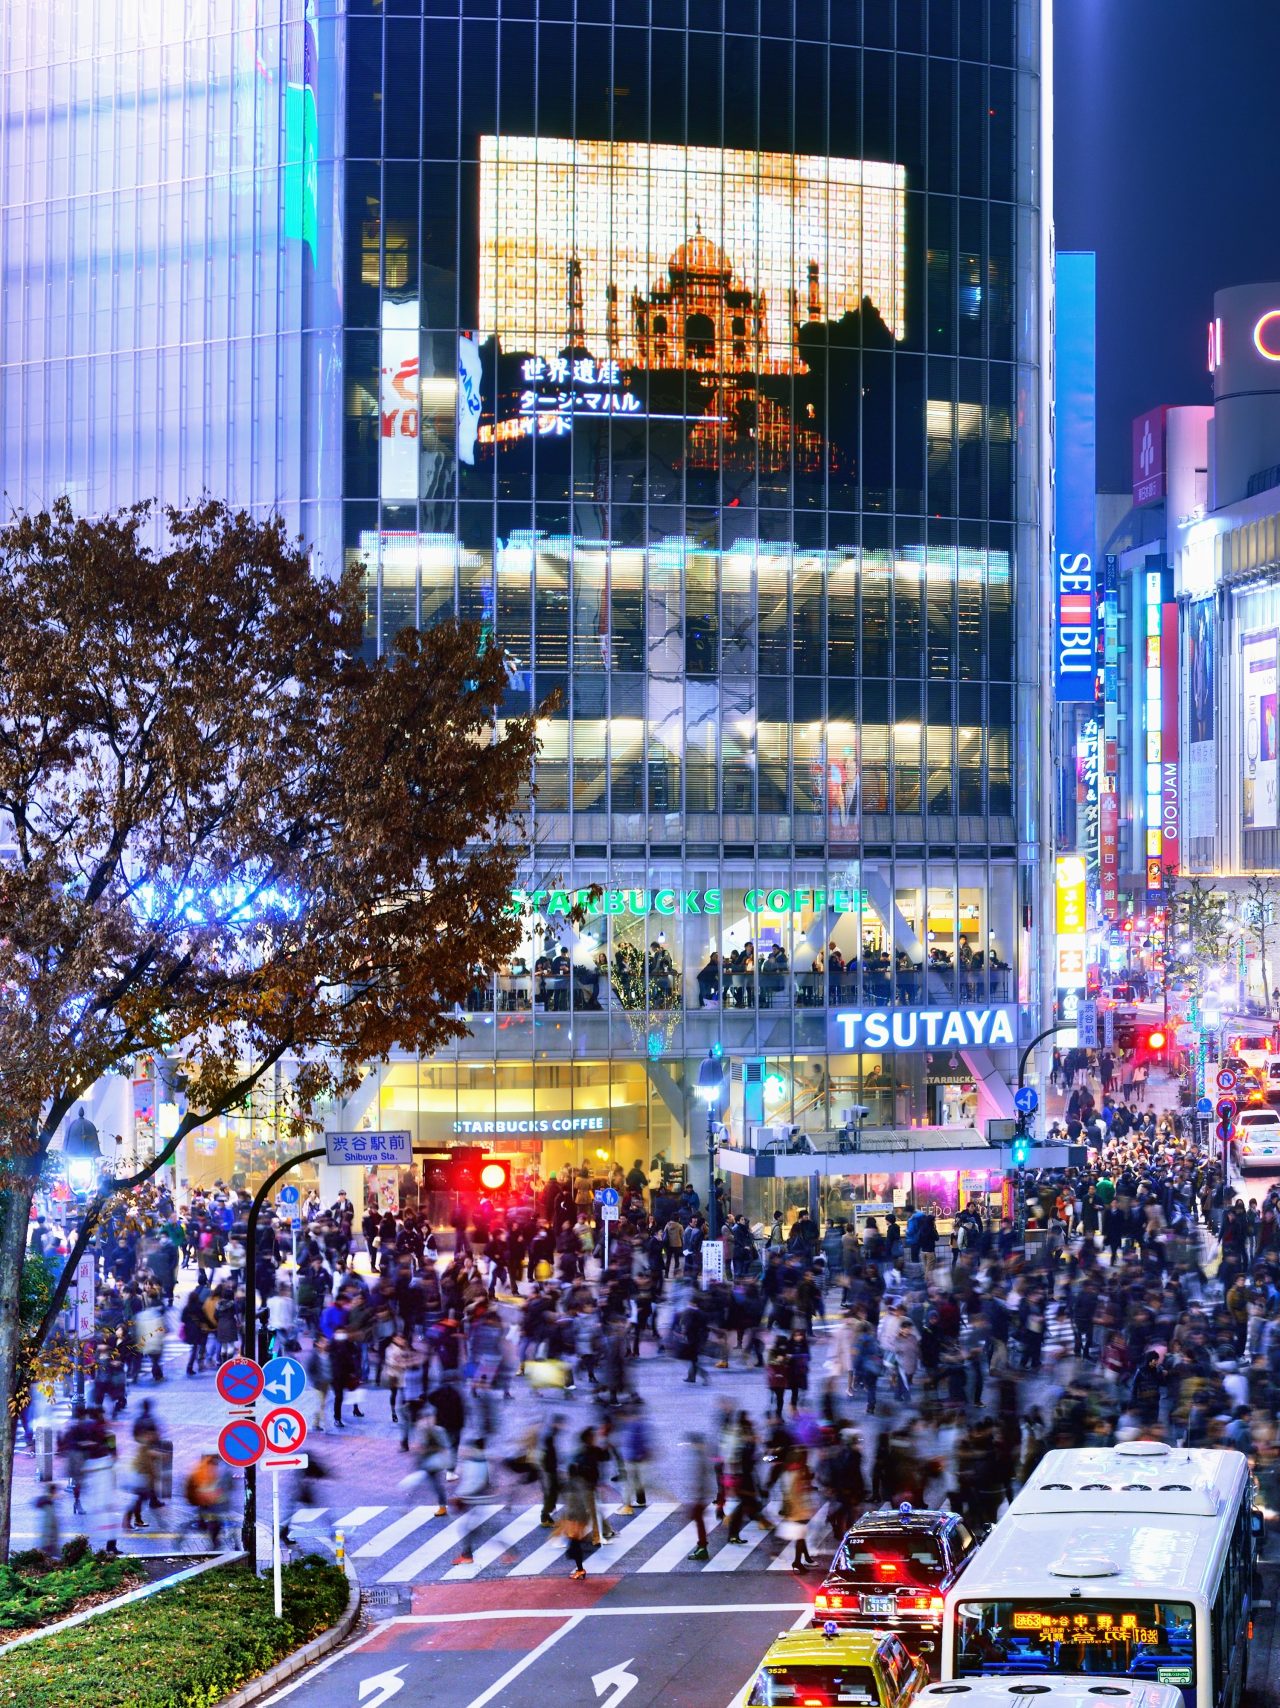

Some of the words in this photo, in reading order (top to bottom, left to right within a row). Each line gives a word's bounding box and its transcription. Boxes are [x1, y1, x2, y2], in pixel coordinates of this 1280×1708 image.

[521, 357, 620, 385] 世界遺産
[520, 390, 641, 411] タージ・マハル
[520, 415, 573, 436] インド
[1060, 553, 1092, 674] SEIBU
[1104, 835, 1116, 920] 東日本銀行
[504, 889, 722, 916] STARBUCKS
[744, 889, 869, 914] COFFEE
[836, 1009, 1015, 1048] TSUTAYA
[1084, 1004, 1095, 1045] 渋谷駅前
[453, 1116, 549, 1133] STARBUCKS
[551, 1116, 603, 1131] COFFEE
[332, 1135, 405, 1151] 渋谷駅前
[344, 1152, 378, 1162] Shibuya
[380, 1152, 398, 1162] Sta.
[80, 1263, 90, 1330] 道玄坂
